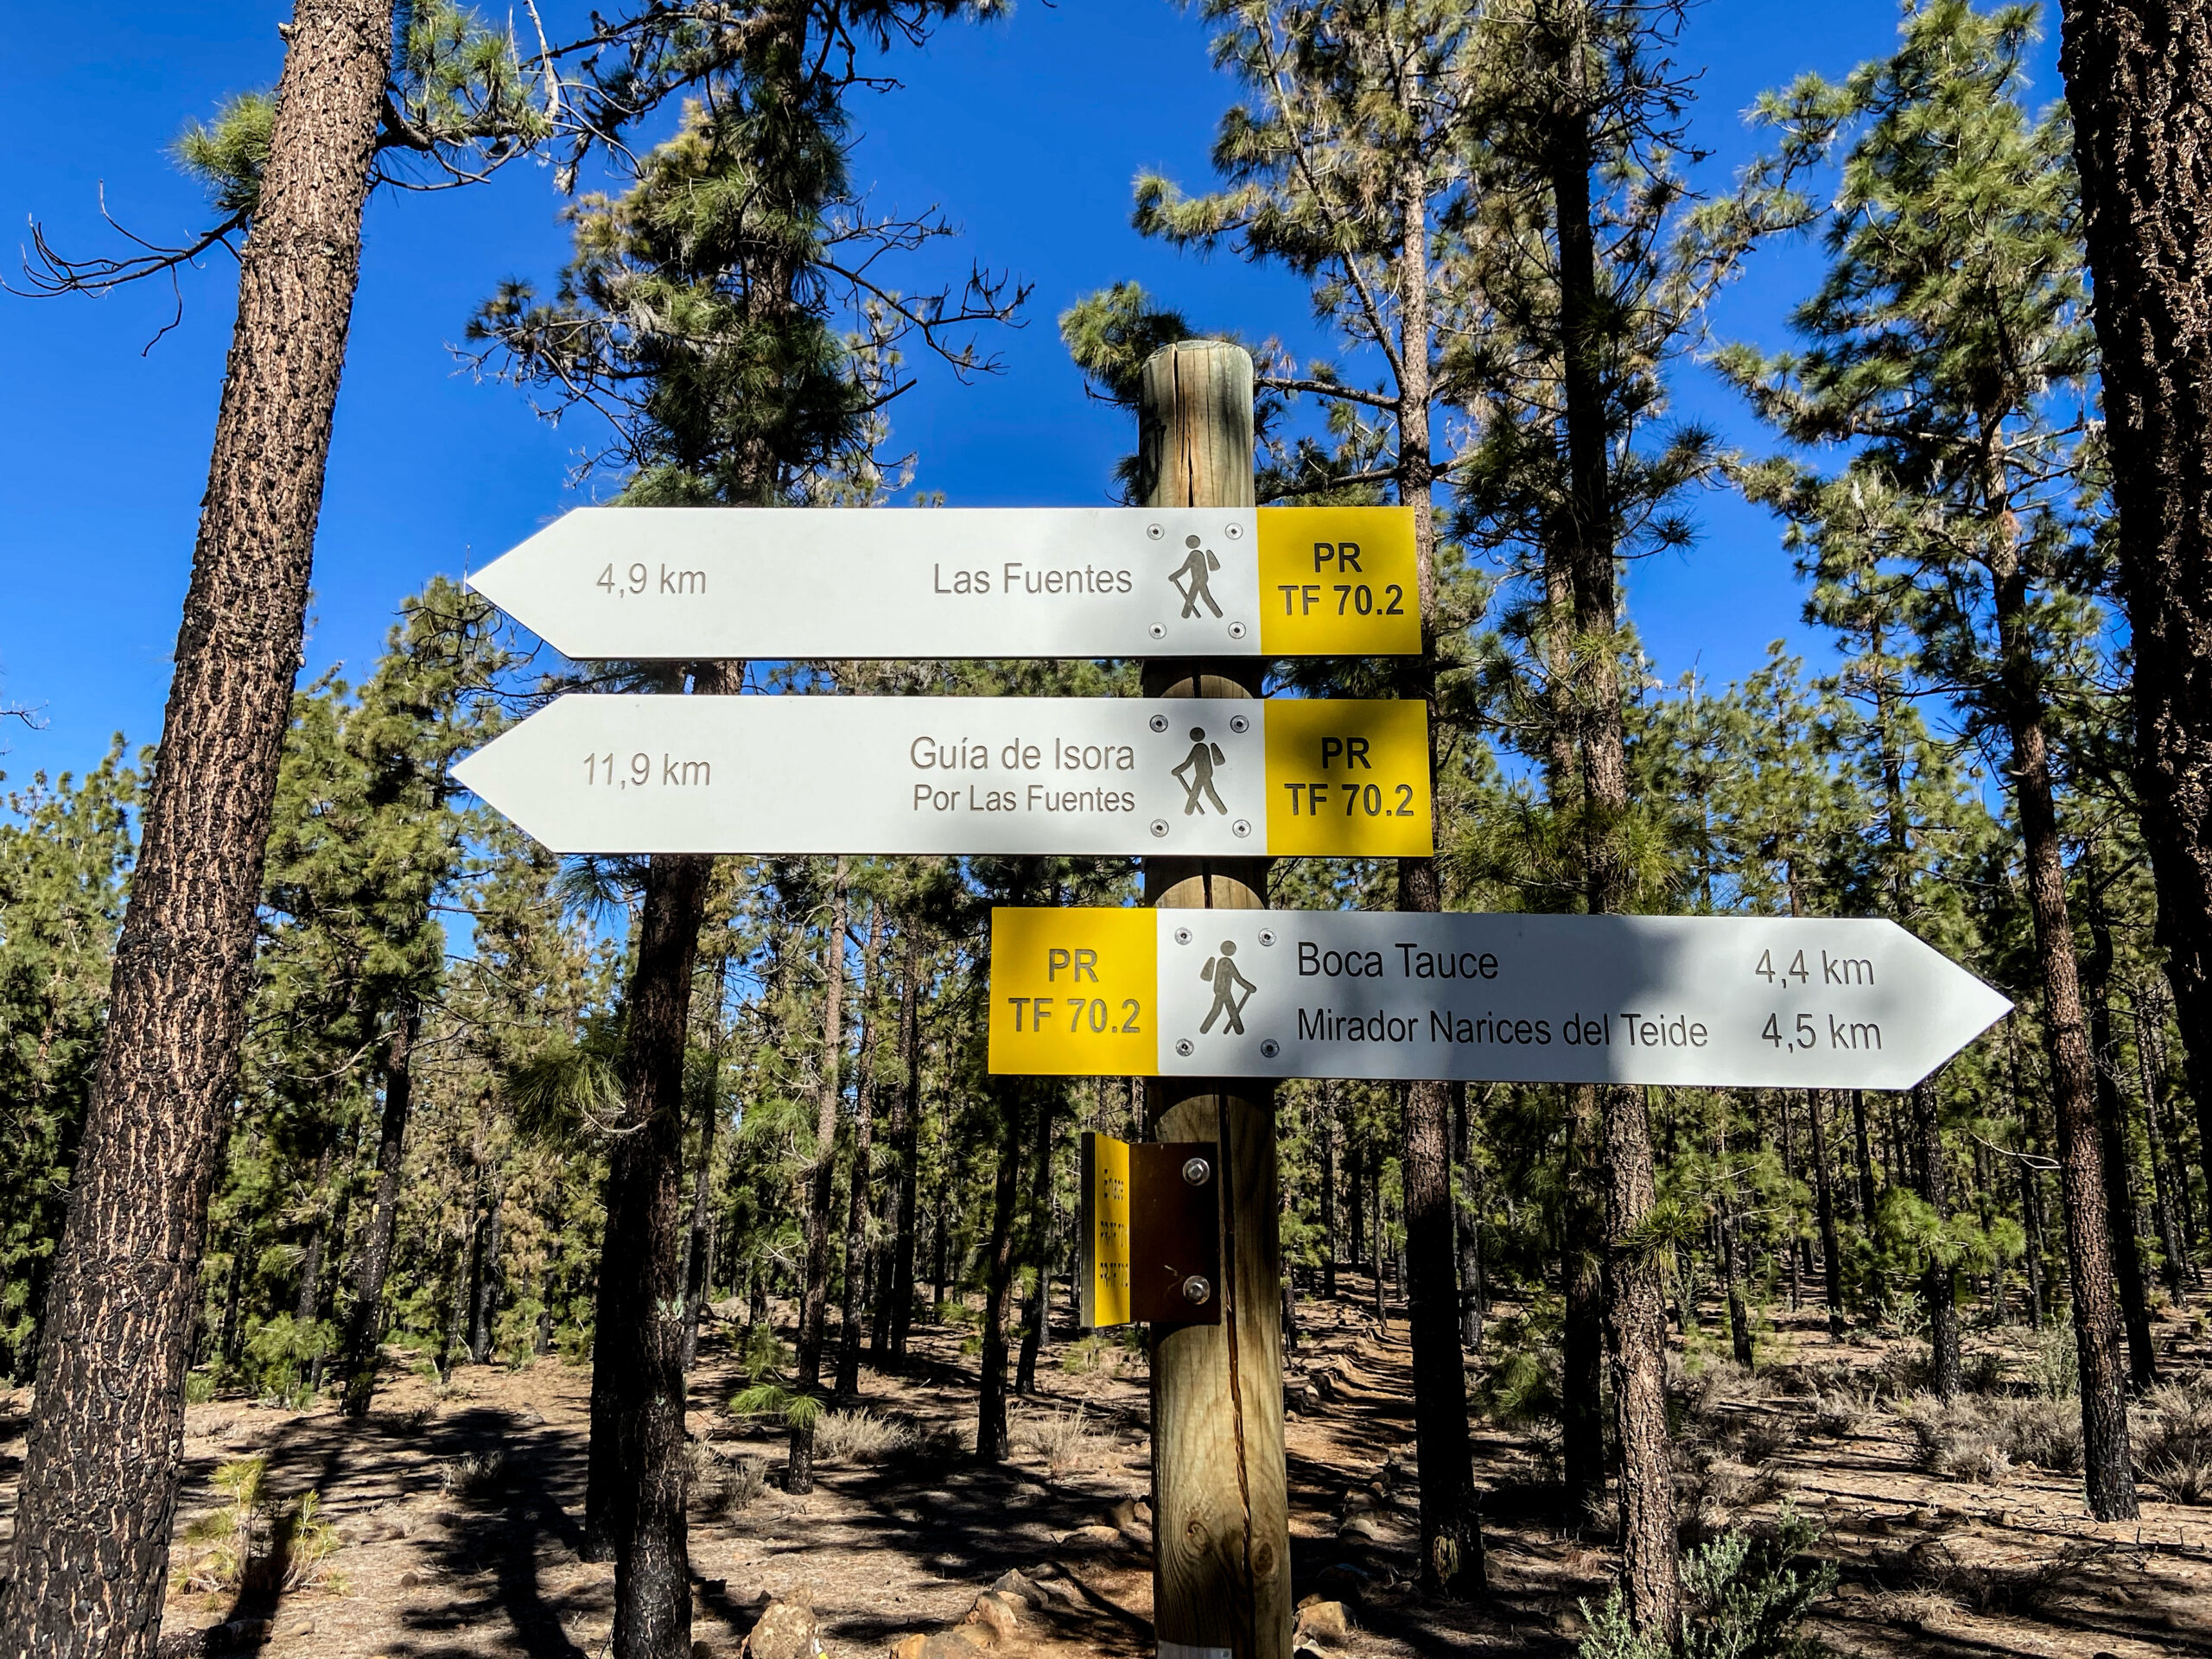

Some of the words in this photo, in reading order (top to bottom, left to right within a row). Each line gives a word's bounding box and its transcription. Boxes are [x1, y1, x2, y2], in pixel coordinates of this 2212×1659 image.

[1314, 543, 1363, 572] PR
[596, 563, 647, 598] 4,9
[660, 563, 706, 594] km
[935, 563, 990, 594] Las
[1004, 563, 1132, 594] Fuentes
[1278, 585, 1320, 615] TF
[1334, 584, 1403, 615] 70.2
[911, 736, 988, 770] Guía
[1001, 738, 1040, 770] de
[1056, 738, 1134, 771] Isora
[1322, 737, 1370, 769] PR
[583, 753, 650, 790] 11,9
[664, 753, 710, 785] km
[914, 785, 961, 811] Por
[970, 785, 1016, 811] Las
[1028, 785, 1135, 812] Fuentes
[1284, 783, 1328, 816] TF
[1342, 784, 1414, 817] 70.2
[1049, 949, 1099, 982] PR
[1299, 942, 1382, 977] Boca
[1395, 944, 1498, 979] Tauce
[1756, 950, 1808, 988] 4,4
[1822, 950, 1873, 985] km
[1008, 998, 1053, 1032] TF
[1067, 999, 1141, 1033] 70.2
[1299, 1008, 1418, 1042] Mirador
[1430, 1010, 1551, 1045] Narices
[1563, 1013, 1609, 1046] del
[1622, 1014, 1707, 1047] Teide
[1762, 1013, 1815, 1053] 4,5
[1829, 1014, 1881, 1049] km
